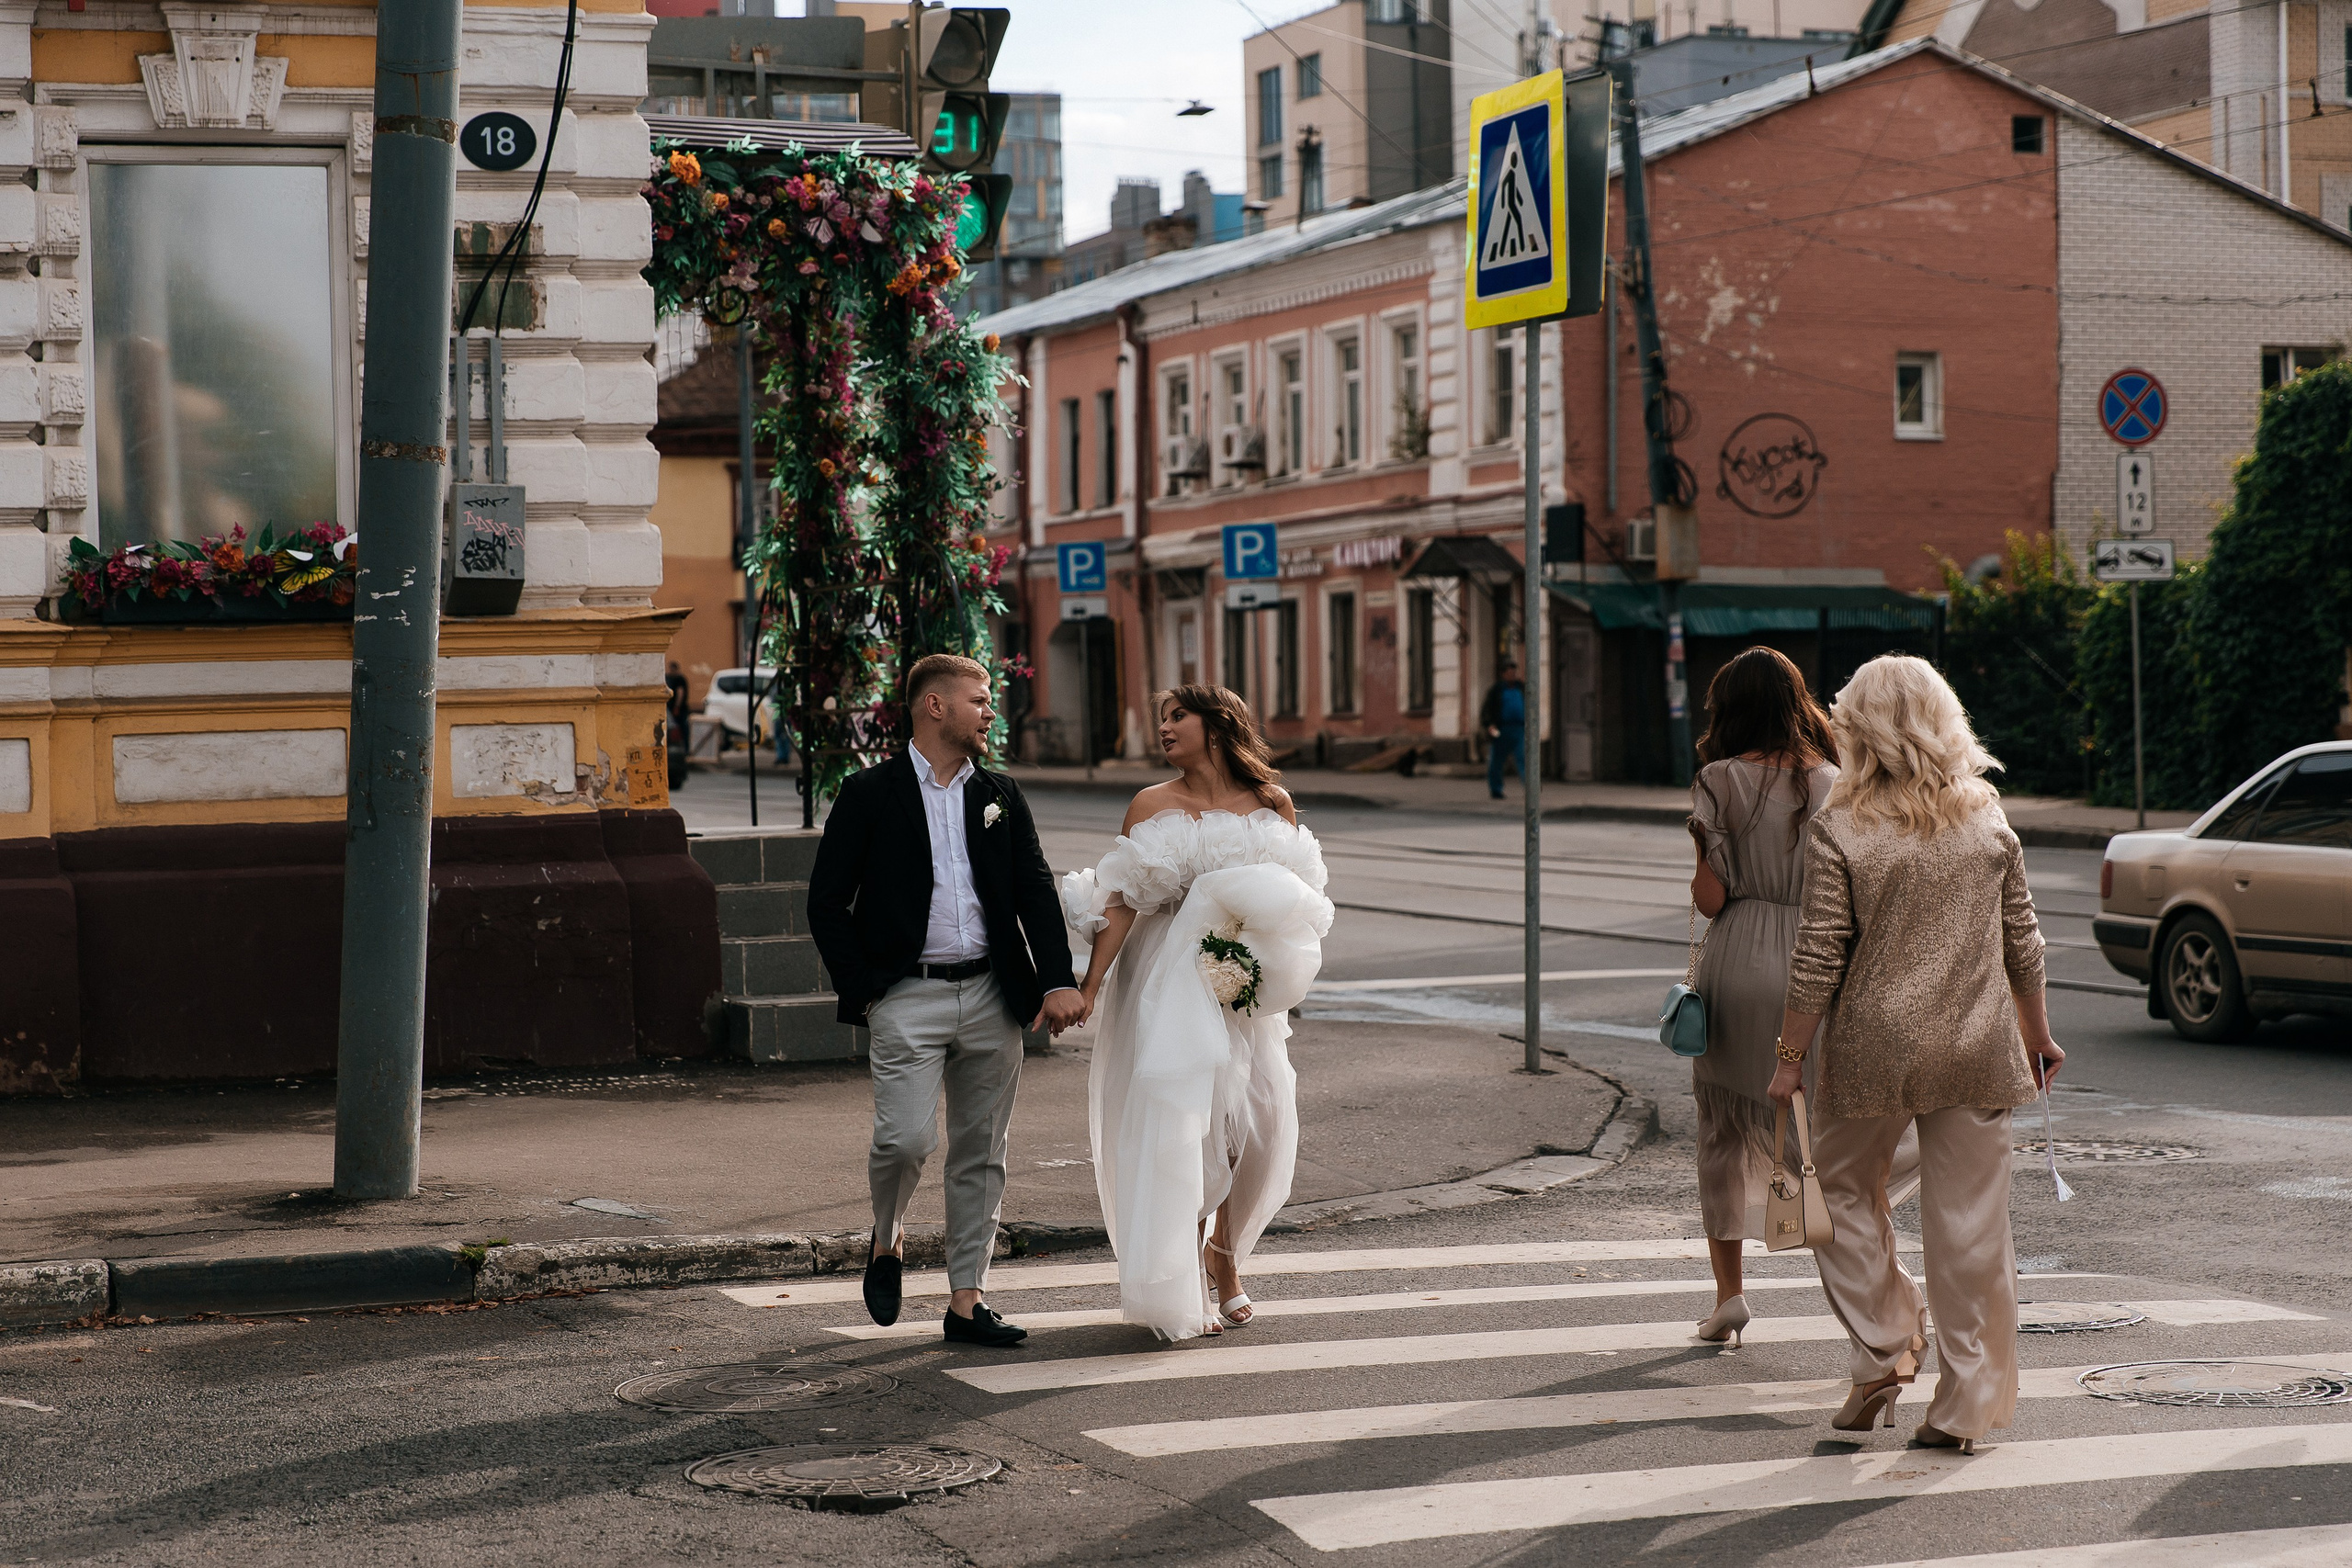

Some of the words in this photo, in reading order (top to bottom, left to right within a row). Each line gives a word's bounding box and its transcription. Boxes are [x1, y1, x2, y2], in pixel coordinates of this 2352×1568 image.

[481, 126, 516, 156] 18
[934, 112, 978, 153] 31
[2126, 491, 2148, 512] 12
[1069, 547, 1094, 586] P
[1235, 531, 1265, 573] P
